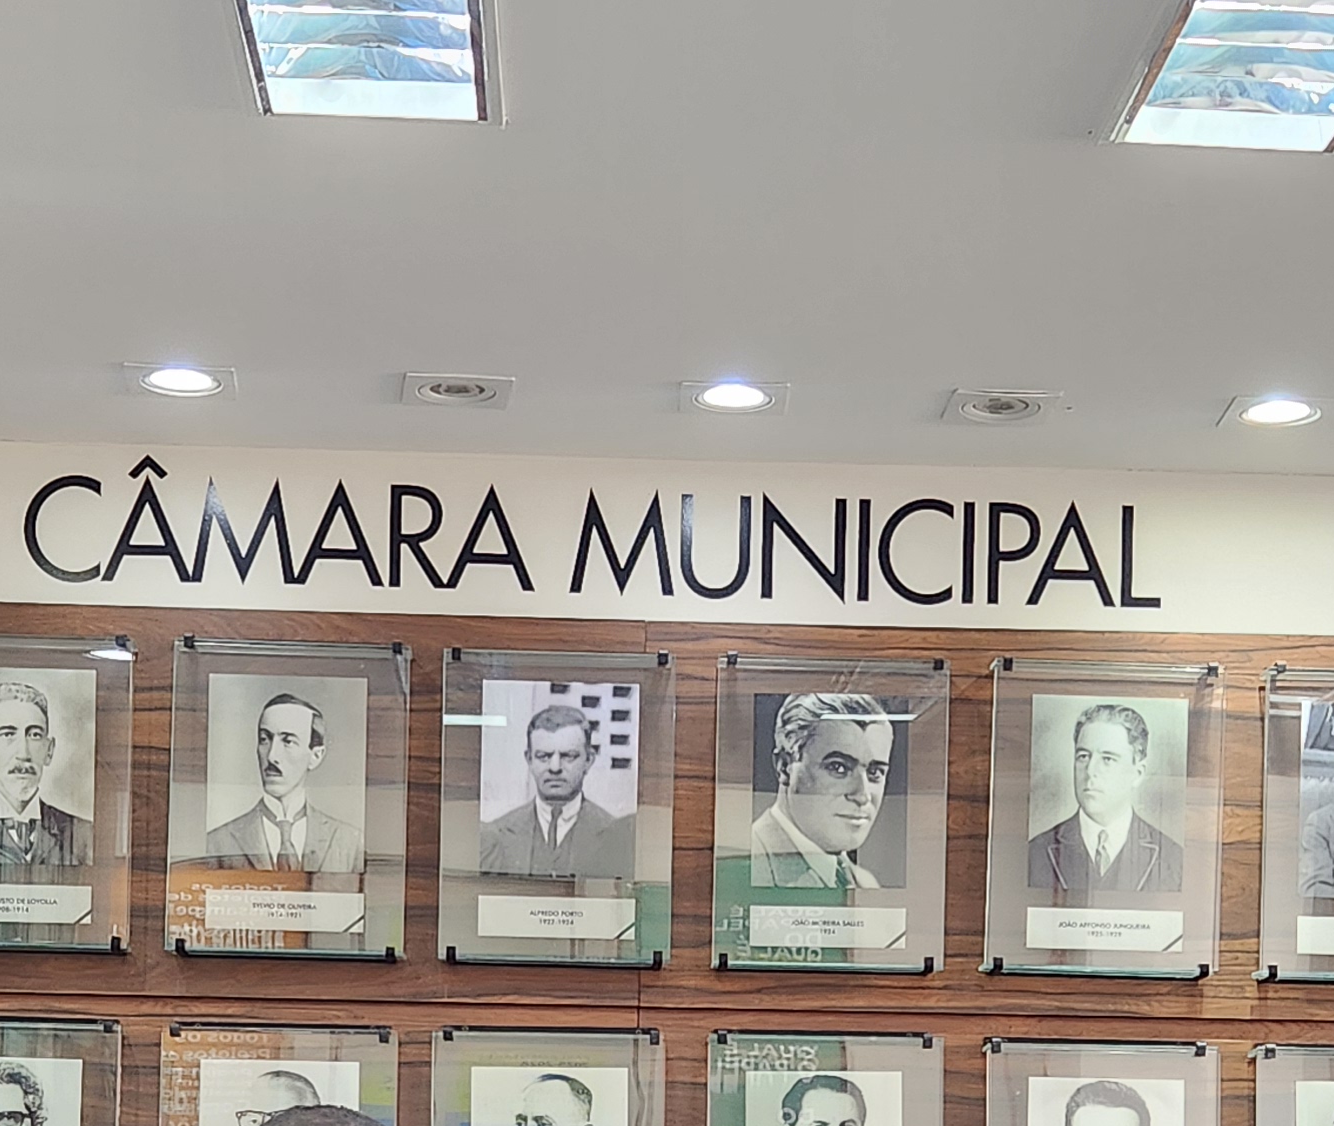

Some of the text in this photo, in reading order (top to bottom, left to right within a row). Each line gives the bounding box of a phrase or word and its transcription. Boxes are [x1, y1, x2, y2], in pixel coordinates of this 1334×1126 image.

[23, 454, 535, 592] CÂMARA
[569, 487, 1162, 608] MUNICIPAL
[28, 898, 59, 906] LOYOLLA
[252, 902, 275, 911] SYLVIO
[277, 903, 286, 911] DE
[530, 910, 559, 918] ALFREDO
[791, 918, 865, 928] JOÃO MOREIRA SALLES
[1058, 920, 1151, 931] JOÃO AFFONSO JUNQUEIRA
